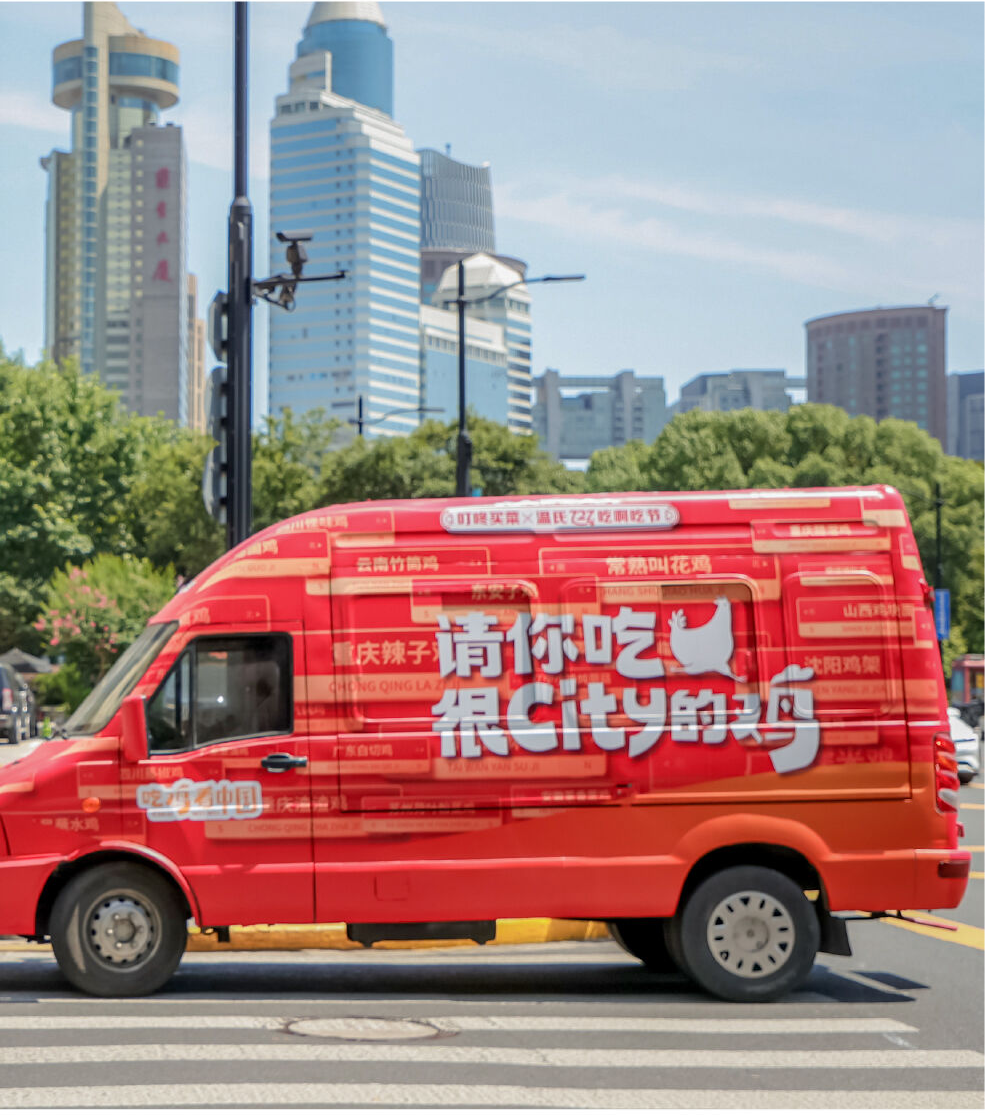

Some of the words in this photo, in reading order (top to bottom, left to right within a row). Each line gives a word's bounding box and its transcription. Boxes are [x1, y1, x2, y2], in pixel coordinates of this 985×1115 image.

[357, 555, 440, 573] 云南竹筒鸡
[605, 554, 713, 575] 常熟叫花鸡
[435, 605, 665, 679] 请你吃
[803, 654, 881, 675] 沈阳鸡架
[379, 680, 414, 693] QING
[431, 665, 821, 775] 很City的鸡
[141, 783, 258, 814] 吃鸡看中国
